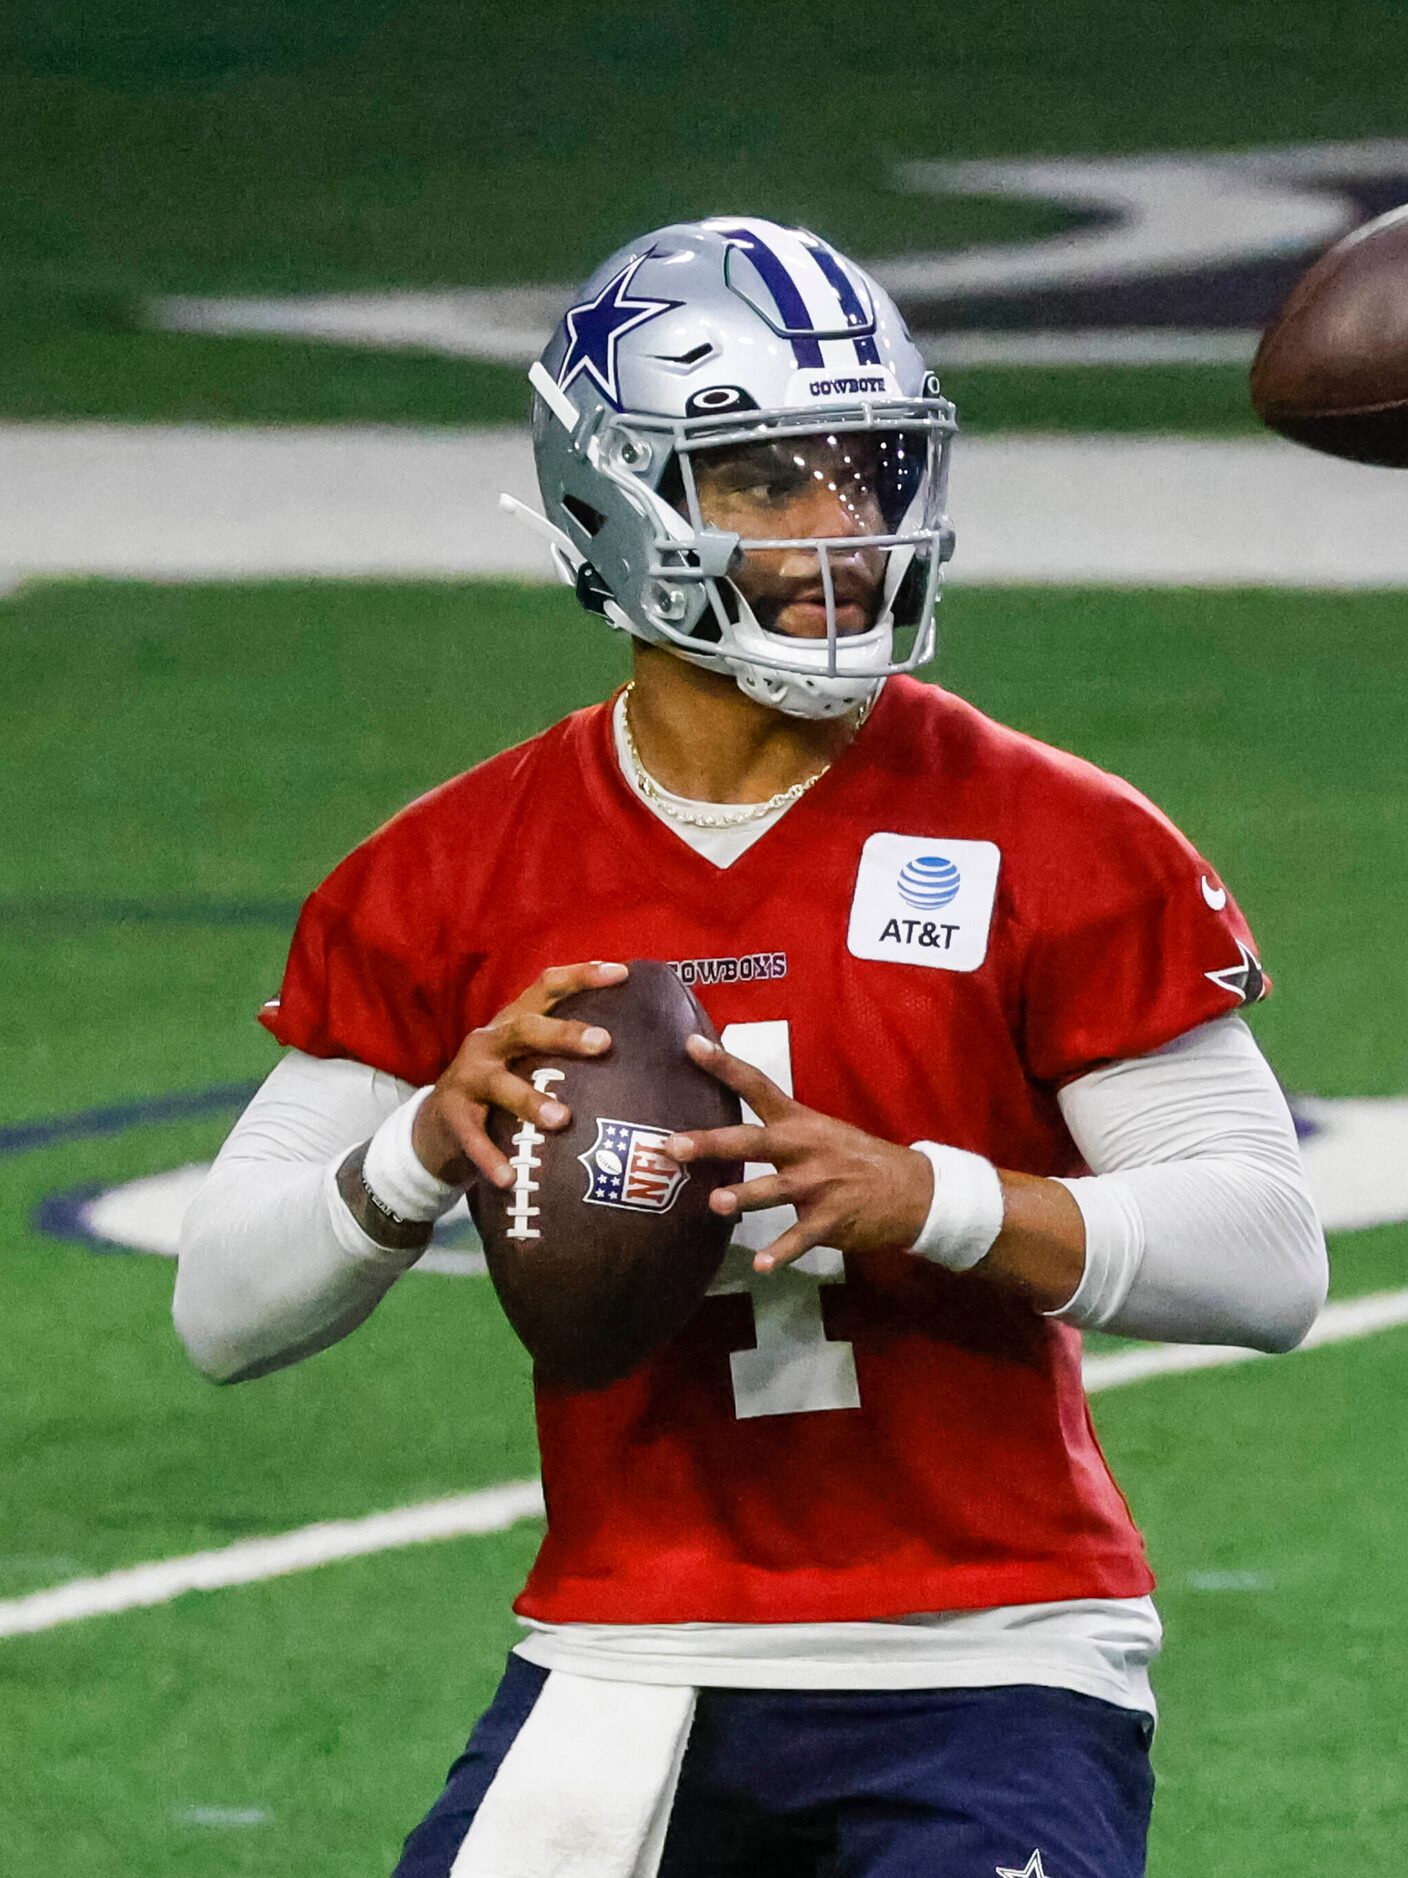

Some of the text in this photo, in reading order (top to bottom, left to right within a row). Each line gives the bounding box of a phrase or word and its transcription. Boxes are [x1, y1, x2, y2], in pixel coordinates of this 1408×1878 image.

[809, 377, 886, 397] COWBOYS
[878, 918, 961, 950] AT&T
[667, 952, 788, 985] OWBOYS
